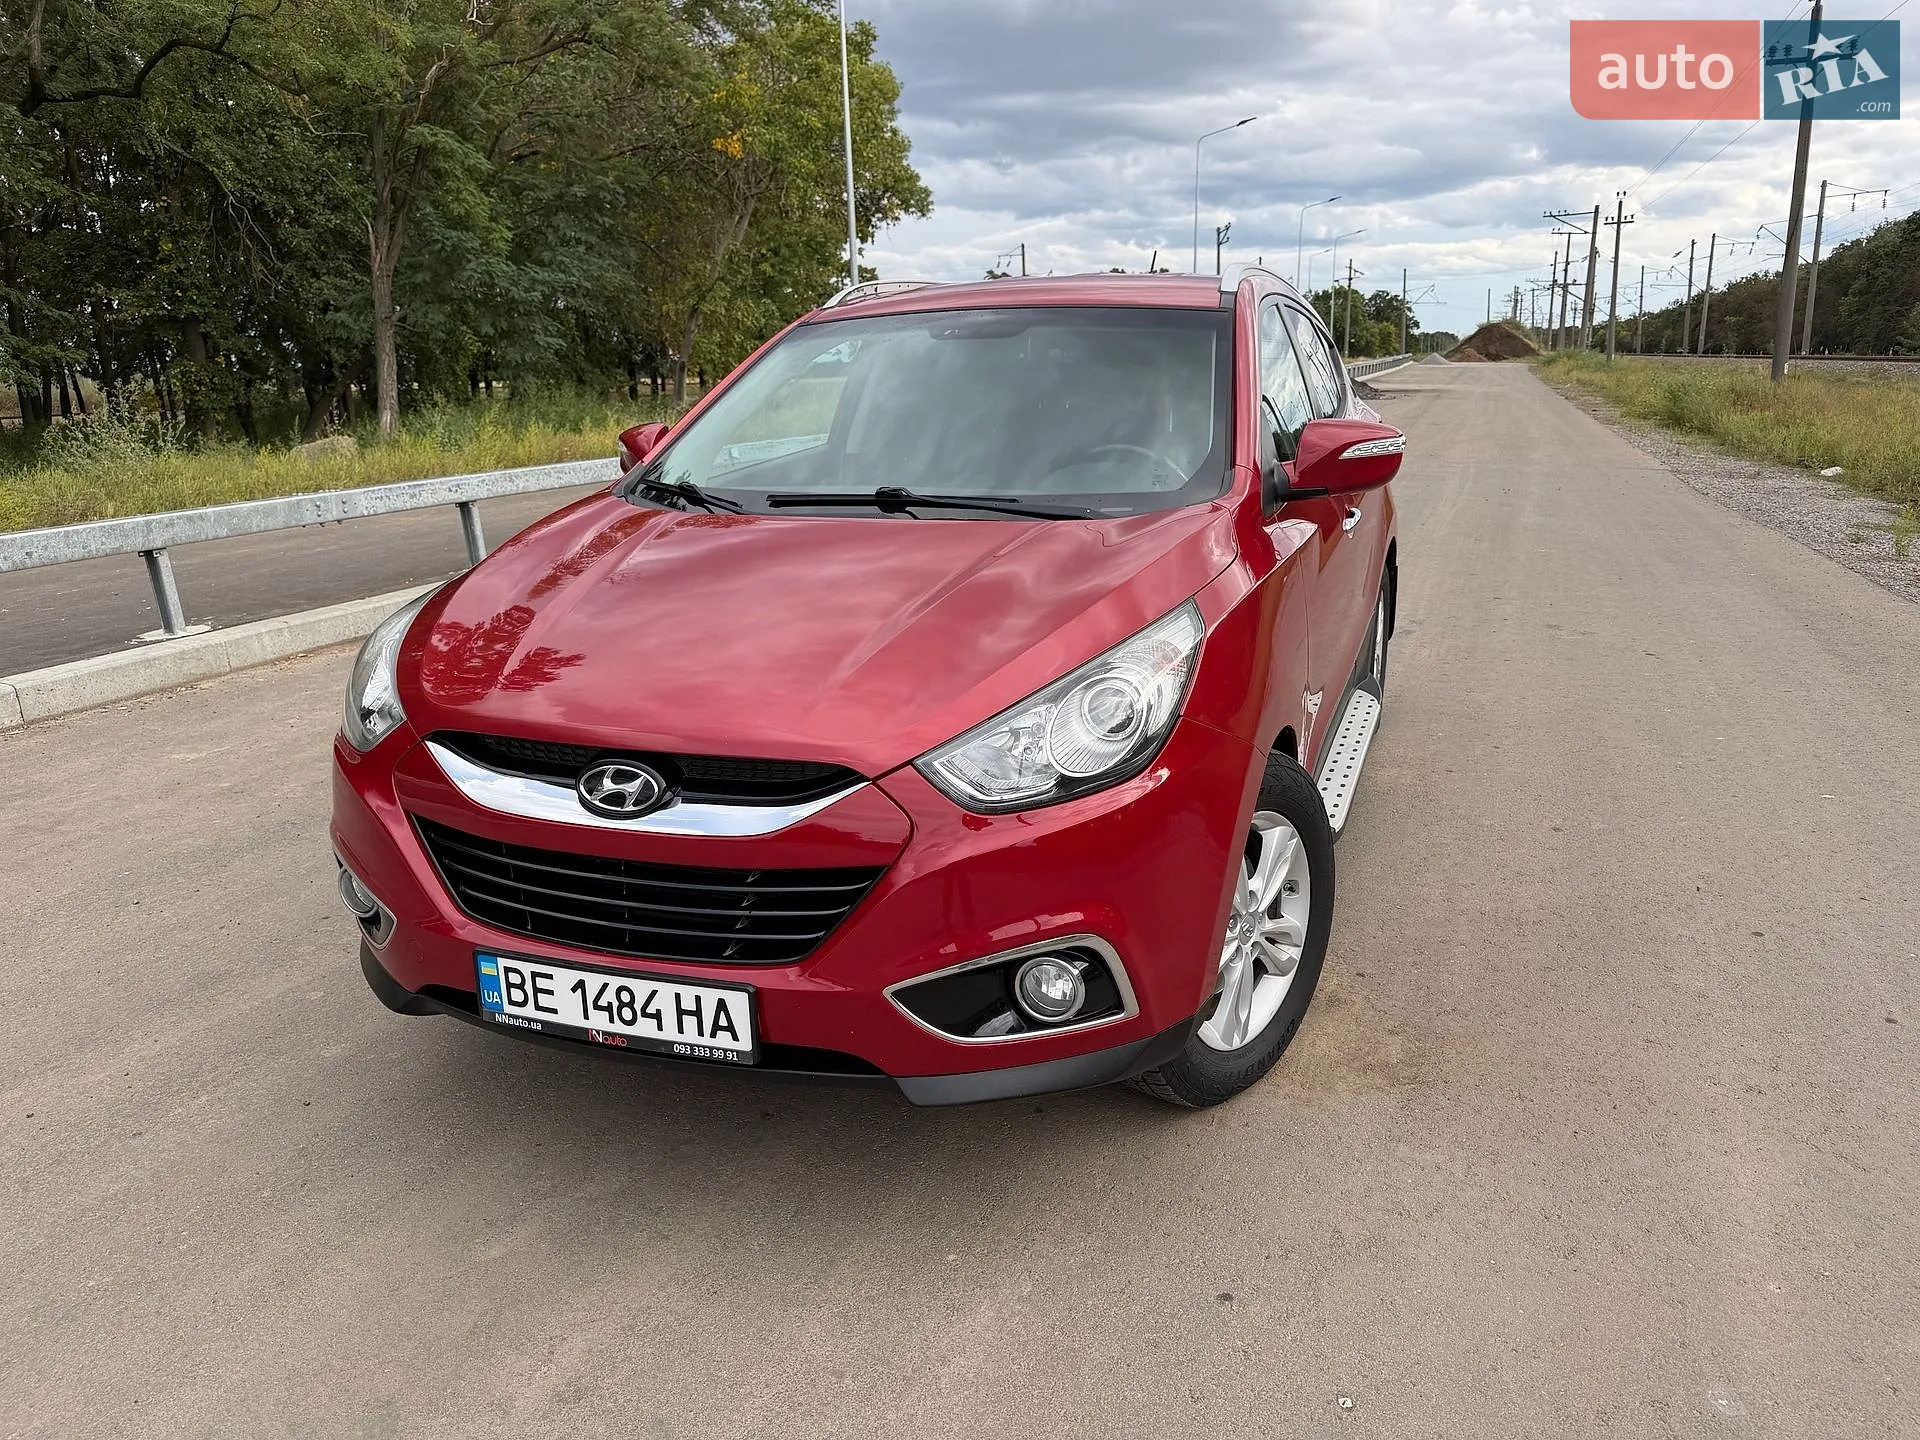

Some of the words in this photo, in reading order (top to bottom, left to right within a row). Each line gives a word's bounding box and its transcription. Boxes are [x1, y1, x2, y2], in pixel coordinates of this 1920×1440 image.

[484, 989, 501, 1005] UA
[503, 965, 559, 1015] BE
[570, 978, 664, 1032] 1484
[675, 991, 740, 1042] HA
[495, 1012, 542, 1031] NNauto.ua
[673, 1043, 691, 1055] 093
[692, 1046, 710, 1058] 333
[711, 1048, 724, 1059] 99
[725, 1050, 738, 1061] 91
